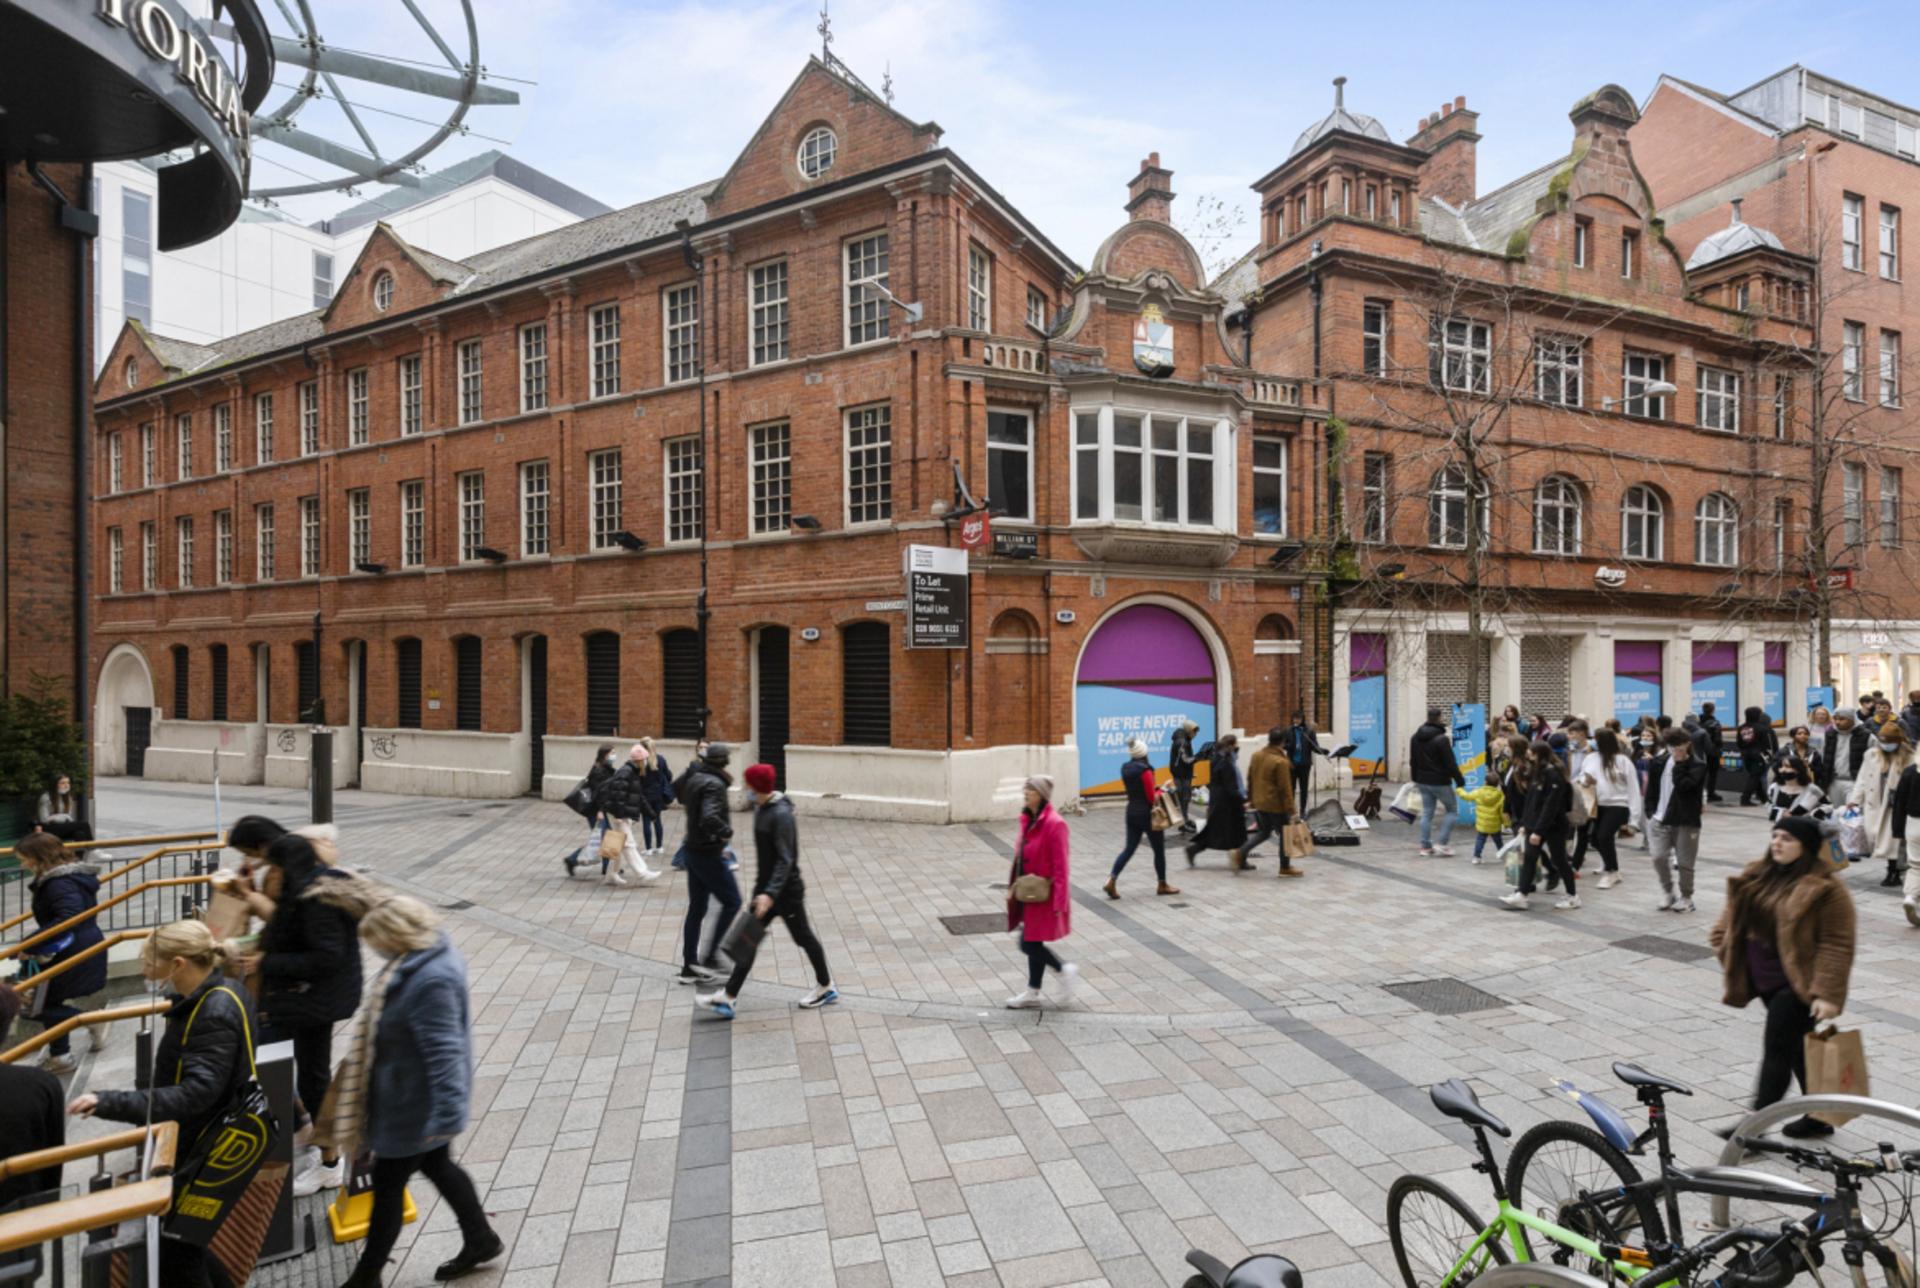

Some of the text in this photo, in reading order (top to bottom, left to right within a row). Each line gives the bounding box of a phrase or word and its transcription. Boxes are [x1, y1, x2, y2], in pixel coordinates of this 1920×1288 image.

[962, 519, 983, 537] Argos
[915, 575, 941, 586] To Let
[915, 592, 935, 602] Prime
[915, 604, 934, 614] Retail
[935, 605, 950, 615] Unit
[1098, 714, 1186, 731] WE'RE NEVER
[1098, 733, 1124, 747] FAR
